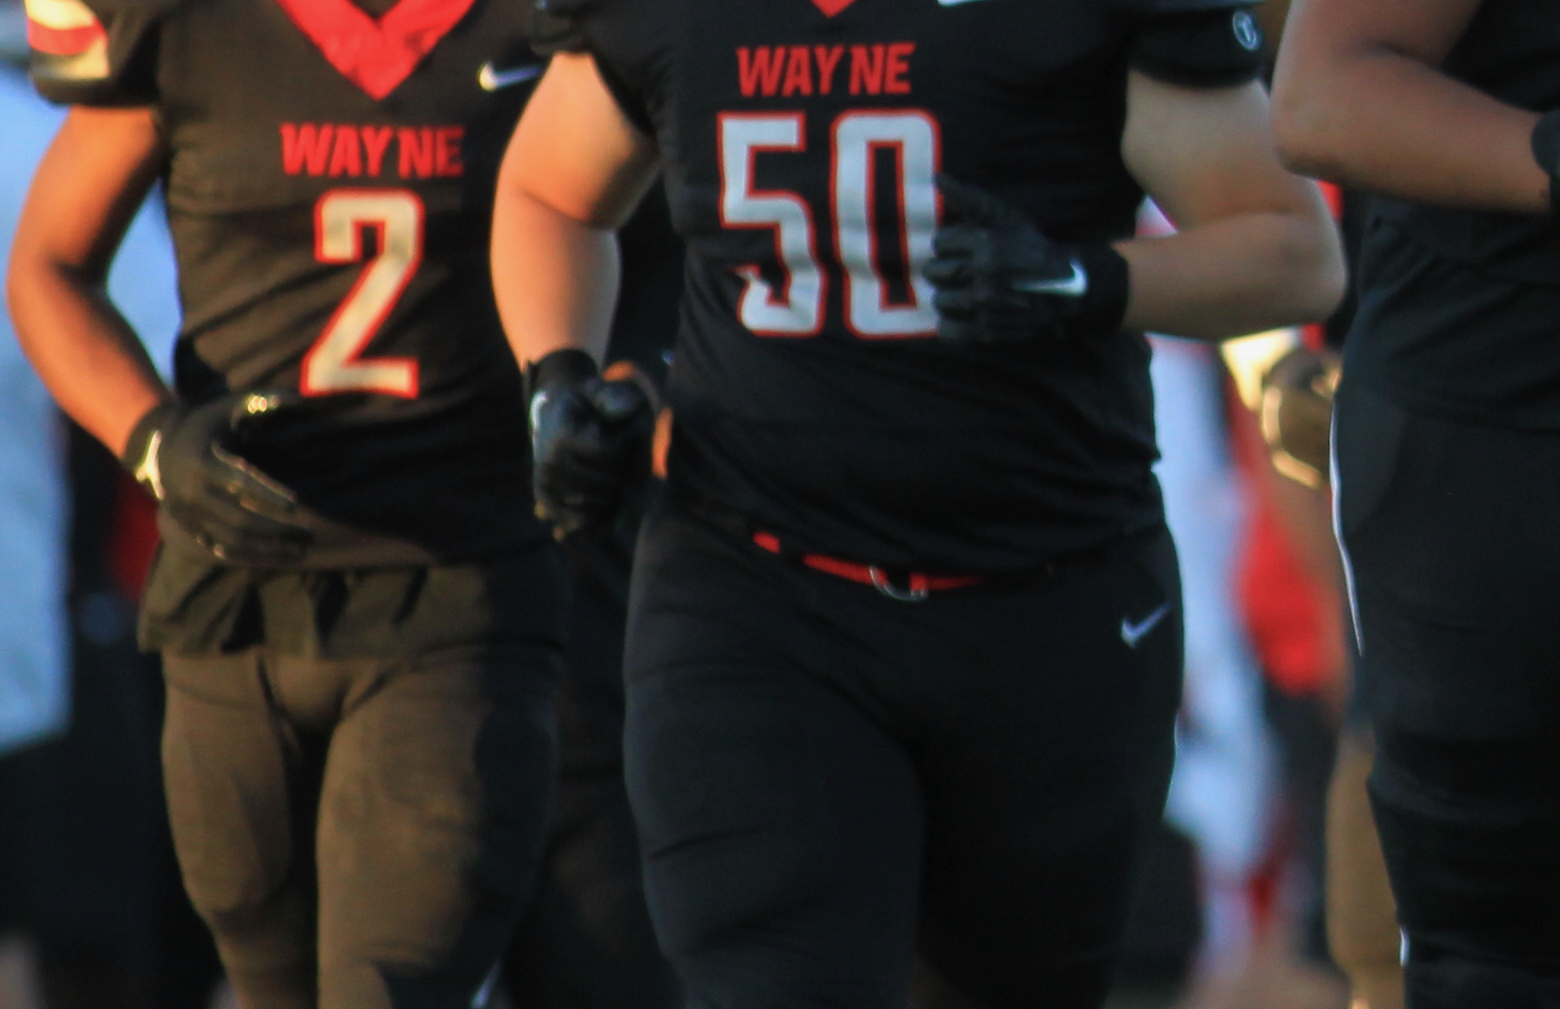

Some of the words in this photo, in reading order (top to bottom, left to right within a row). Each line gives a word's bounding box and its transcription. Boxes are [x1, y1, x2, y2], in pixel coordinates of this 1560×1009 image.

[735, 42, 916, 98] WAYNE
[280, 122, 465, 179] WAYNE
[716, 107, 942, 339] 50
[301, 187, 424, 400] 2
